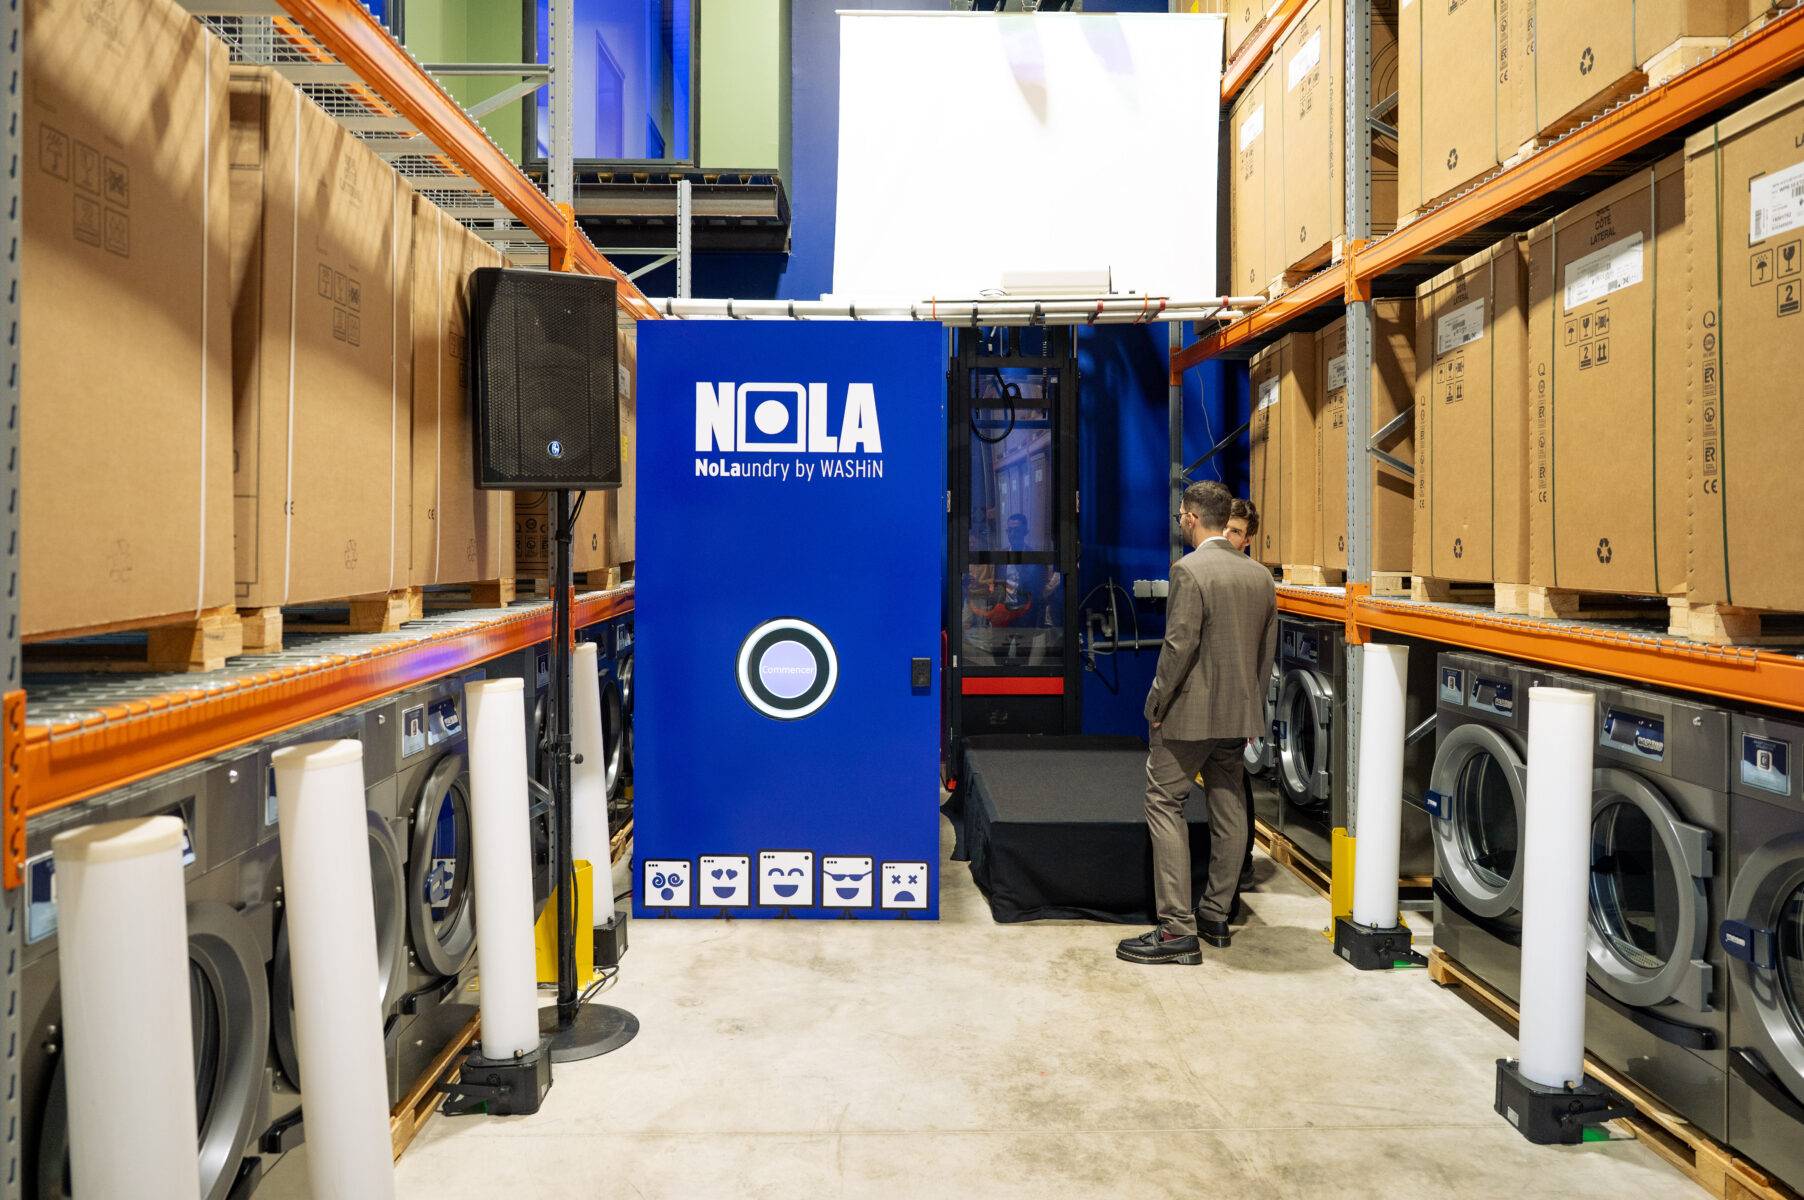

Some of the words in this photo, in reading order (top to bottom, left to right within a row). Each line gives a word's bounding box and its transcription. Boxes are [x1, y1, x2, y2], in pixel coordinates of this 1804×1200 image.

[1785, 284, 1794, 302] 2
[695, 381, 883, 453] NOLA
[695, 458, 790, 482] NoLaundry
[795, 458, 815, 482] by
[820, 459, 883, 478] WASHiN
[1703, 478, 1718, 494] CE
[762, 665, 815, 674] Commencer
